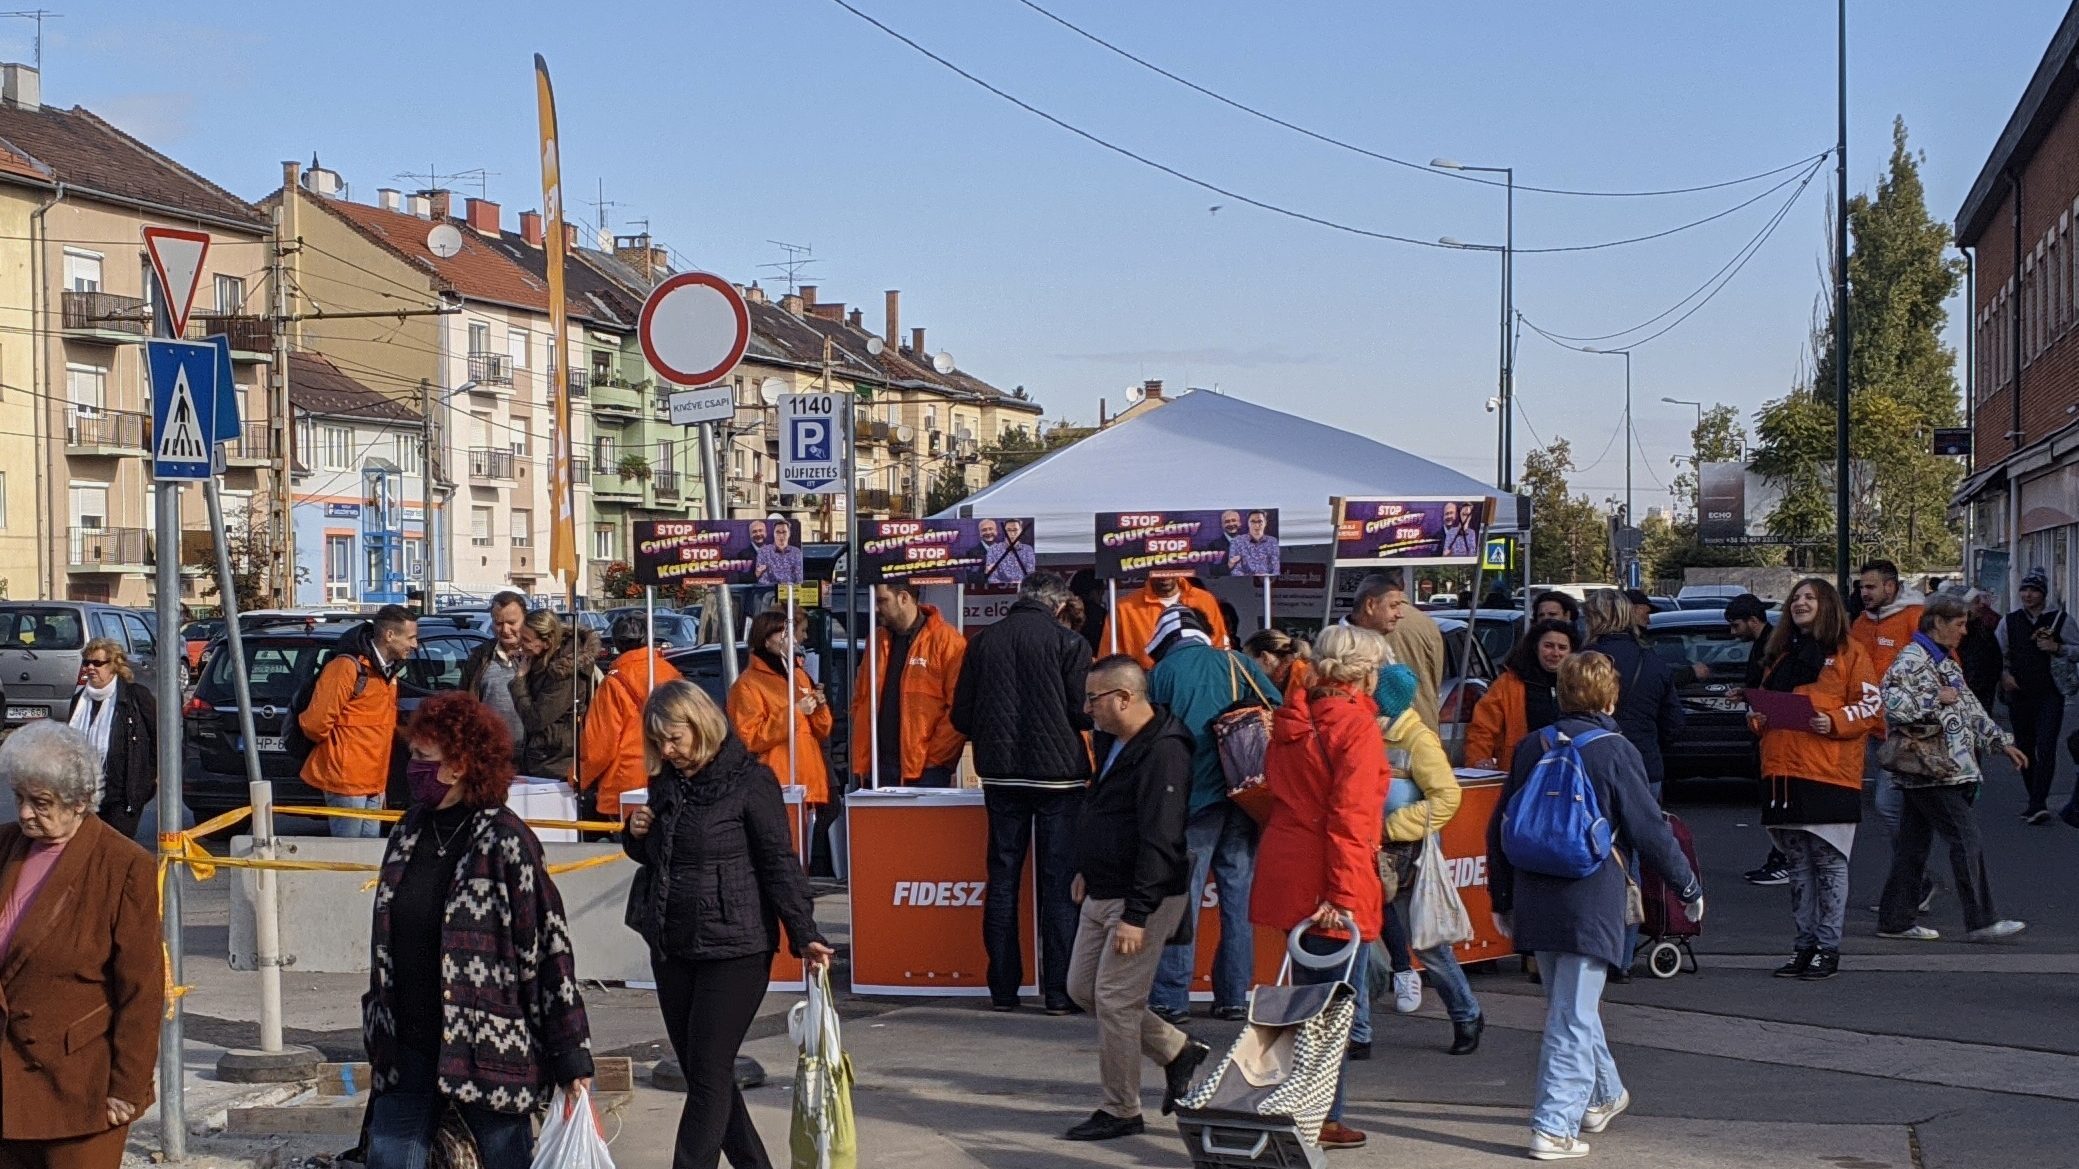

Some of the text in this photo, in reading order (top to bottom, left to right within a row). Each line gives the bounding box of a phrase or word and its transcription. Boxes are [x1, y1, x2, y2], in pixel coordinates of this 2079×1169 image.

[789, 396, 832, 415] 1140
[797, 422, 825, 459] P
[784, 466, 838, 479] DÍJFIZETÉS
[1377, 505, 1402, 516] STOP
[1120, 515, 1160, 527] STOP
[657, 524, 694, 536] STOP
[881, 523, 920, 535] STOP
[1102, 520, 1201, 547] Gyurcsány
[1395, 529, 1420, 540] STOP
[640, 529, 731, 555] Gyurcsány
[863, 528, 960, 554] Gyurcsány
[1147, 540, 1188, 552] STOP
[682, 548, 719, 560] STOP
[907, 547, 946, 560] STOP
[1120, 550, 1226, 572] Karácsony
[656, 558, 753, 579] Karácsony
[963, 601, 1009, 617] az elő
[256, 738, 287, 750] HP-6
[1446, 855, 1488, 888] FIDE
[892, 881, 986, 906] FIDESZ
